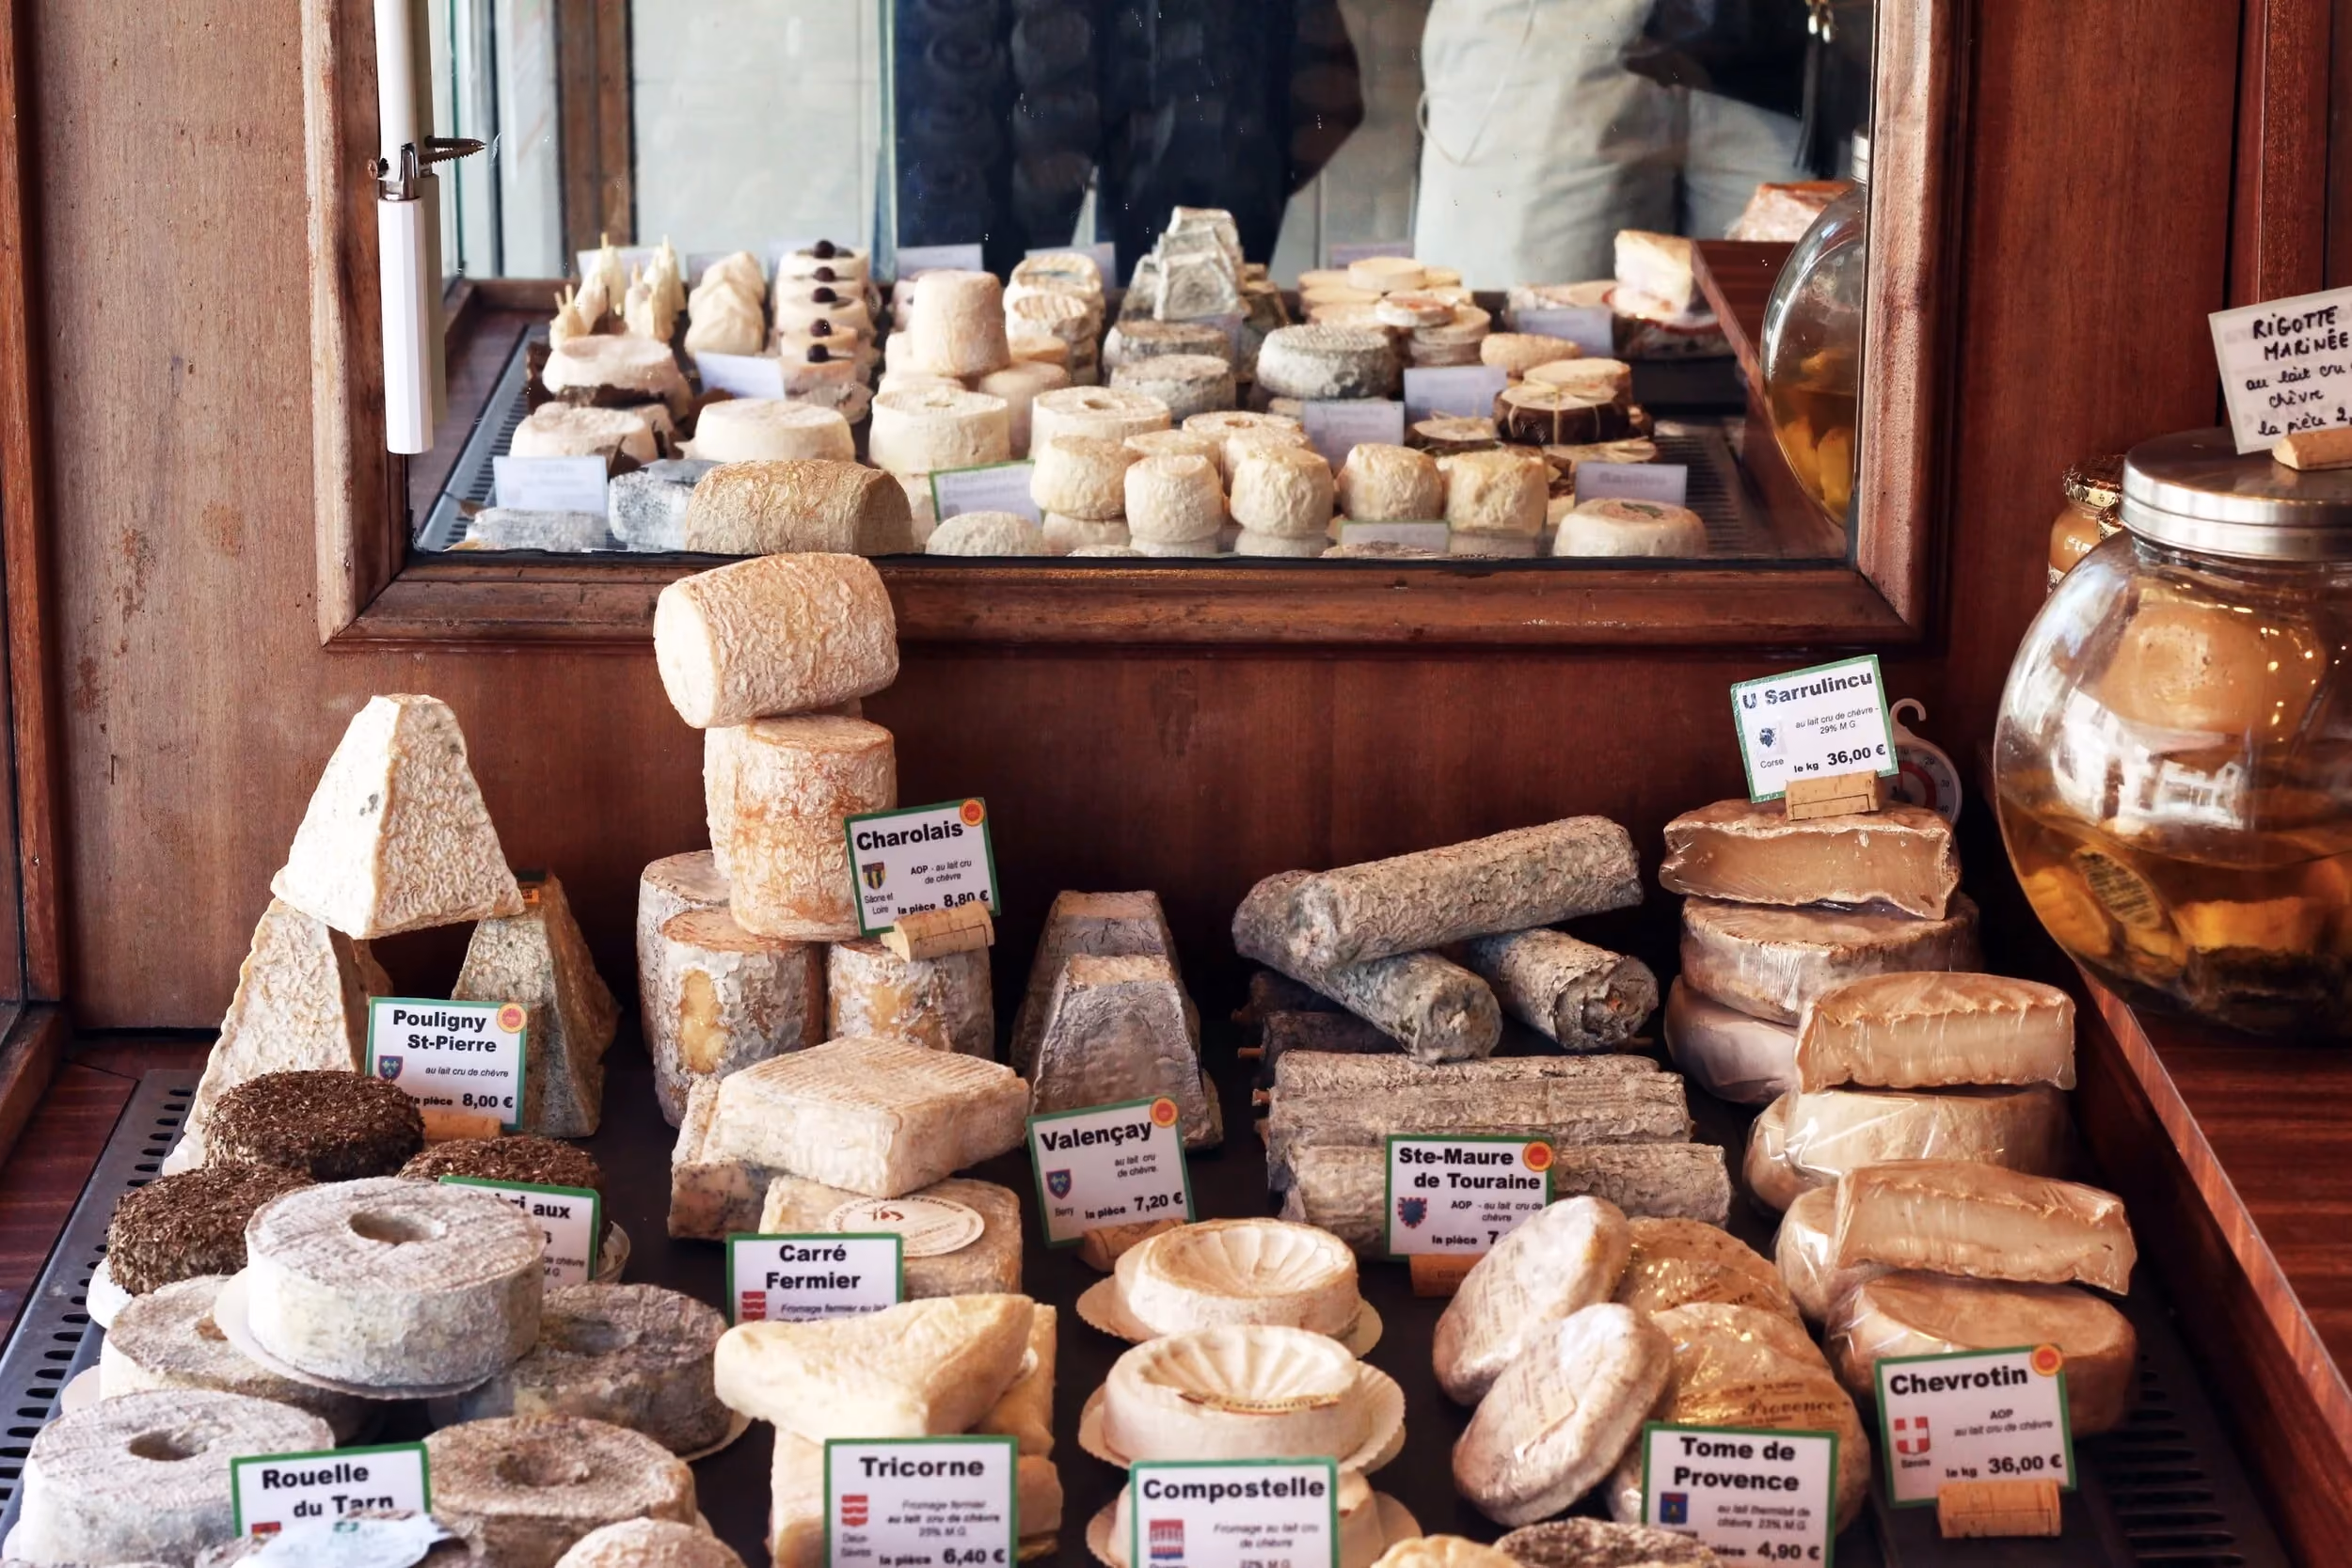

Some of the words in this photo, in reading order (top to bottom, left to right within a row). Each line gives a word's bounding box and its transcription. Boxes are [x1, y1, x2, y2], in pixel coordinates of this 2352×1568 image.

[2246, 379, 2269, 390] au
[2279, 367, 2311, 384] lait
[2319, 364, 2345, 377] cru
[2258, 420, 2280, 436] la
[1742, 692, 1756, 709] U
[1764, 673, 1873, 705] Sarrulincu
[1795, 721, 1805, 729] au
[1807, 717, 1819, 727] lait
[1820, 715, 1835, 724] cru
[1836, 712, 1845, 721] de
[1847, 706, 1873, 718] chèvre
[1820, 724, 1837, 735] 29%
[1760, 758, 1785, 769] Corse
[1794, 765, 1804, 773] le
[1806, 761, 1820, 771] kg
[1827, 747, 1871, 766] 36,00
[1875, 744, 1886, 756] €
[856, 820, 963, 850] Charolais
[911, 865, 929, 875] AOP
[946, 862, 958, 871] lait
[924, 876, 934, 884] de
[898, 906, 908, 915] la
[979, 890, 990, 901] €
[393, 1009, 486, 1033] Pouligny
[407, 1034, 497, 1053] St-Pierre
[437, 1067, 451, 1075] lait
[480, 1069, 509, 1078] chèvre
[423, 1096, 453, 1106] pièce
[462, 1093, 498, 1110] 8,00
[503, 1096, 513, 1108] €
[1040, 1121, 1152, 1152] Valençay
[1142, 1153, 1155, 1163] cru
[1399, 1148, 1514, 1165] Ste-Maure
[1117, 1169, 1128, 1179] de
[1414, 1172, 1440, 1188] de
[1447, 1173, 1540, 1190] Touraine
[532, 1203, 571, 1219] aux
[1085, 1211, 1095, 1219] la
[1097, 1206, 1126, 1220] pièce
[1134, 1195, 1168, 1212] 7,20
[1172, 1192, 1184, 1205] €
[1451, 1201, 1473, 1210] AOP
[1484, 1202, 1495, 1211] au
[1497, 1201, 1511, 1211] lait
[1515, 1202, 1530, 1211] cru
[1432, 1235, 1442, 1244] la
[1445, 1234, 1477, 1246] pièce
[779, 1243, 847, 1262] Carré
[766, 1272, 861, 1290] Fermier
[1889, 1365, 2028, 1396] Chevrotin
[1990, 1409, 2013, 1419] AOP
[2004, 1422, 2017, 1433] de
[1679, 1436, 1754, 1459] Tome
[1762, 1441, 1795, 1461] de
[859, 1457, 984, 1478] Tricorne
[1946, 1468, 1958, 1478] le
[1961, 1466, 1978, 1478] kg
[1988, 1456, 2044, 1475] 36,00
[2050, 1454, 2062, 1468] €
[262, 1464, 369, 1490] Rouelle
[1674, 1466, 1799, 1491] Provence
[1143, 1477, 1325, 1504] Compostelle
[293, 1500, 323, 1518] du
[880, 1555, 892, 1565] la
[943, 1548, 986, 1565] 6,40
[993, 1548, 1006, 1563] €
[1756, 1541, 1802, 1562] 4,90
[1807, 1545, 1820, 1560] €
